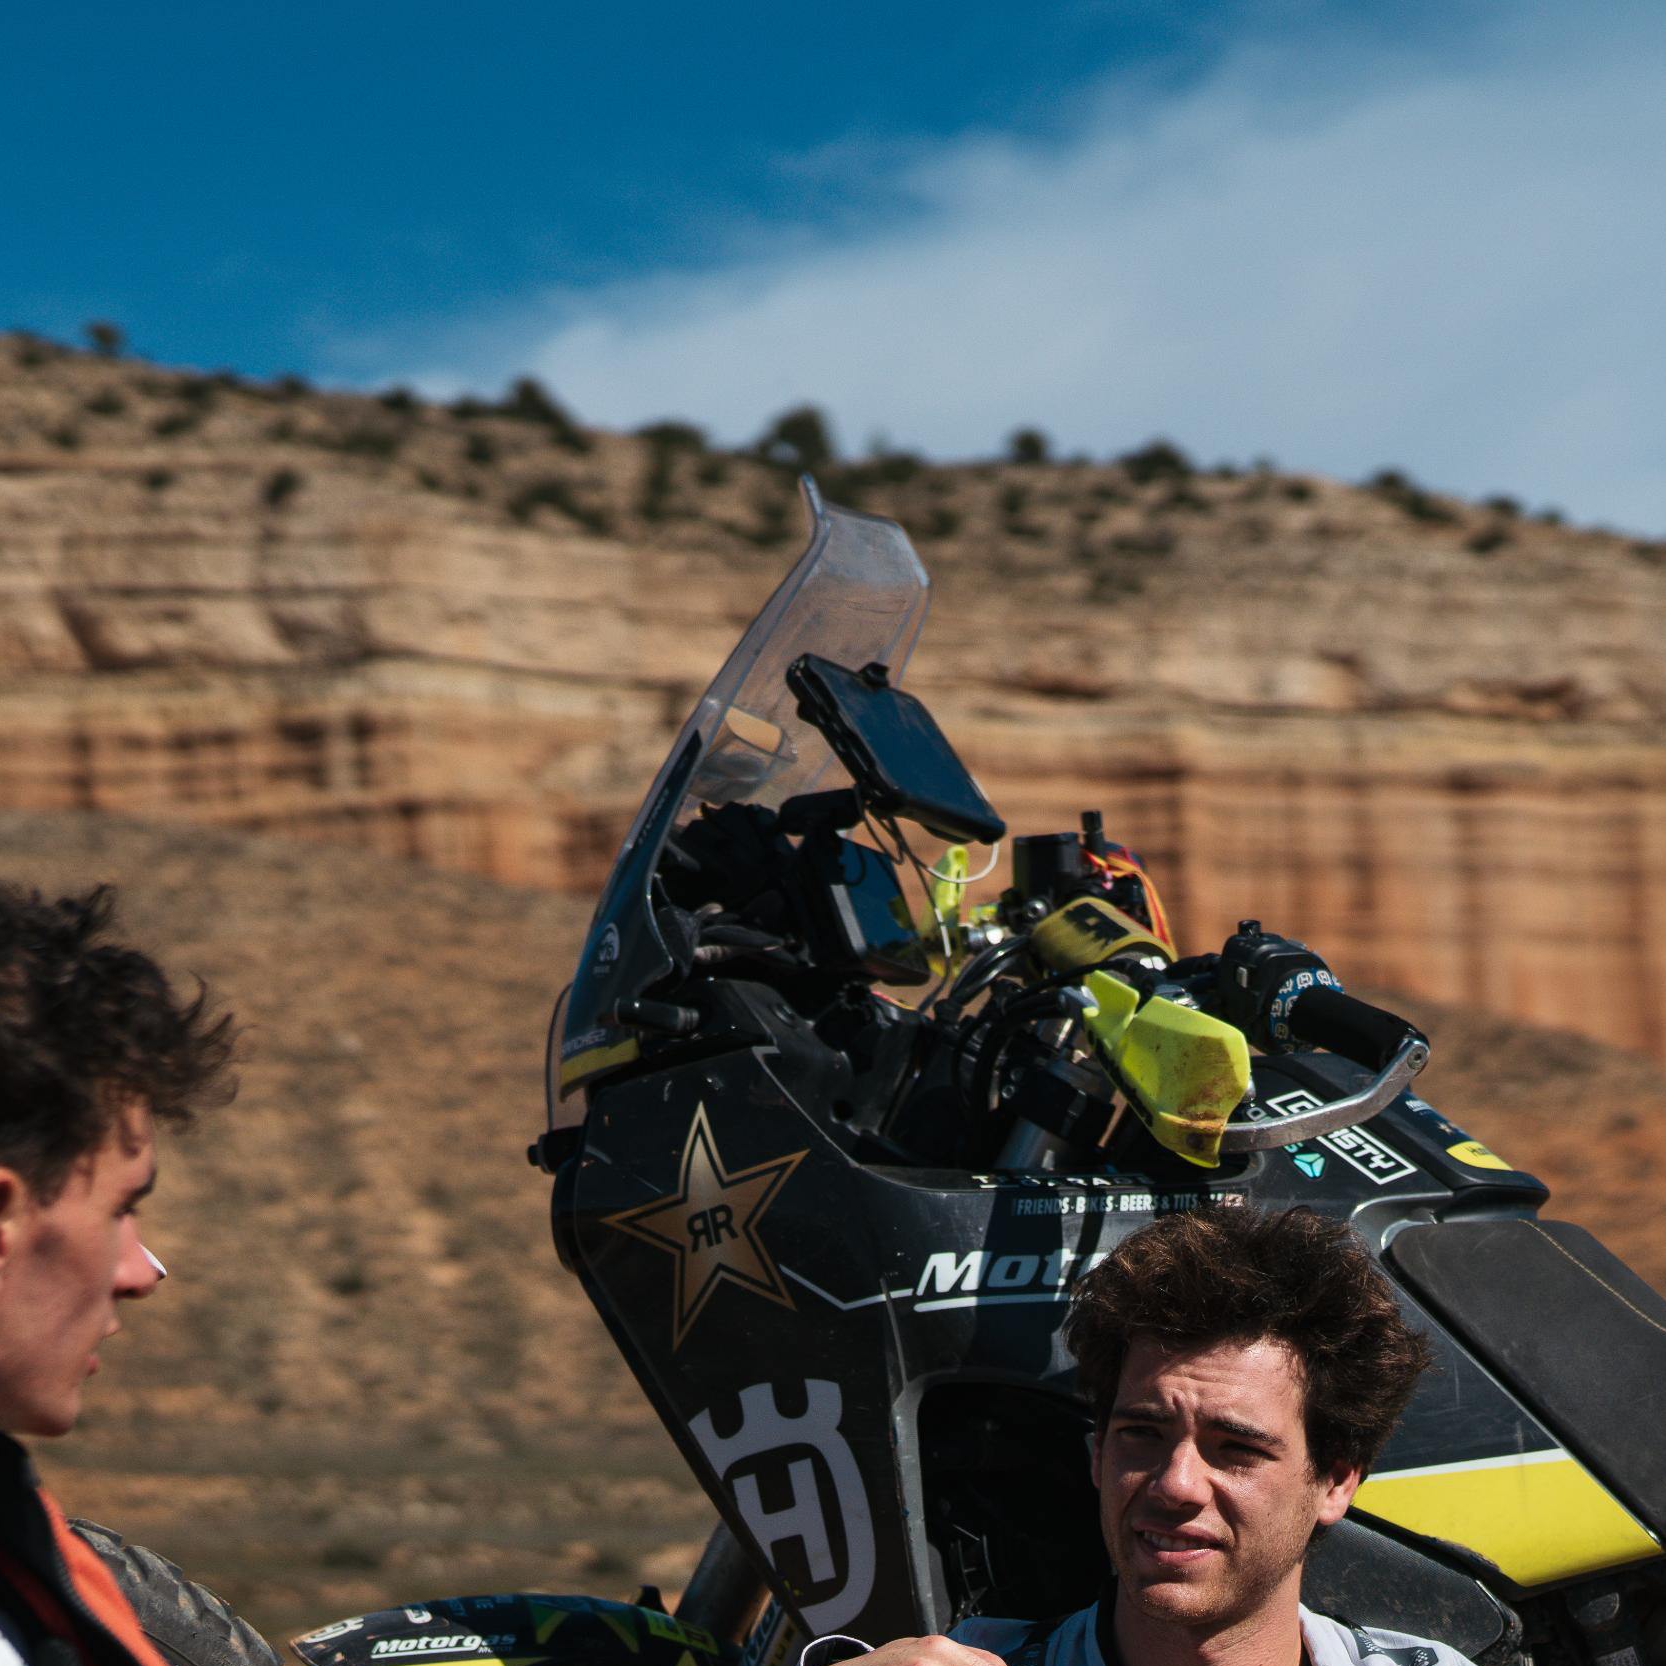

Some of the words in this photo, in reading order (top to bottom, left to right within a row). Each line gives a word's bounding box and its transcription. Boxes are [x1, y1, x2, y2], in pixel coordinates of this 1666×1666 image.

[1016, 1197, 1069, 1215] FRIENDS
[1075, 1194, 1114, 1213] BIKES
[1120, 1193, 1159, 1211] BEERS
[1173, 1192, 1199, 1209] TITS
[370, 1634, 518, 1657] Motorgas
